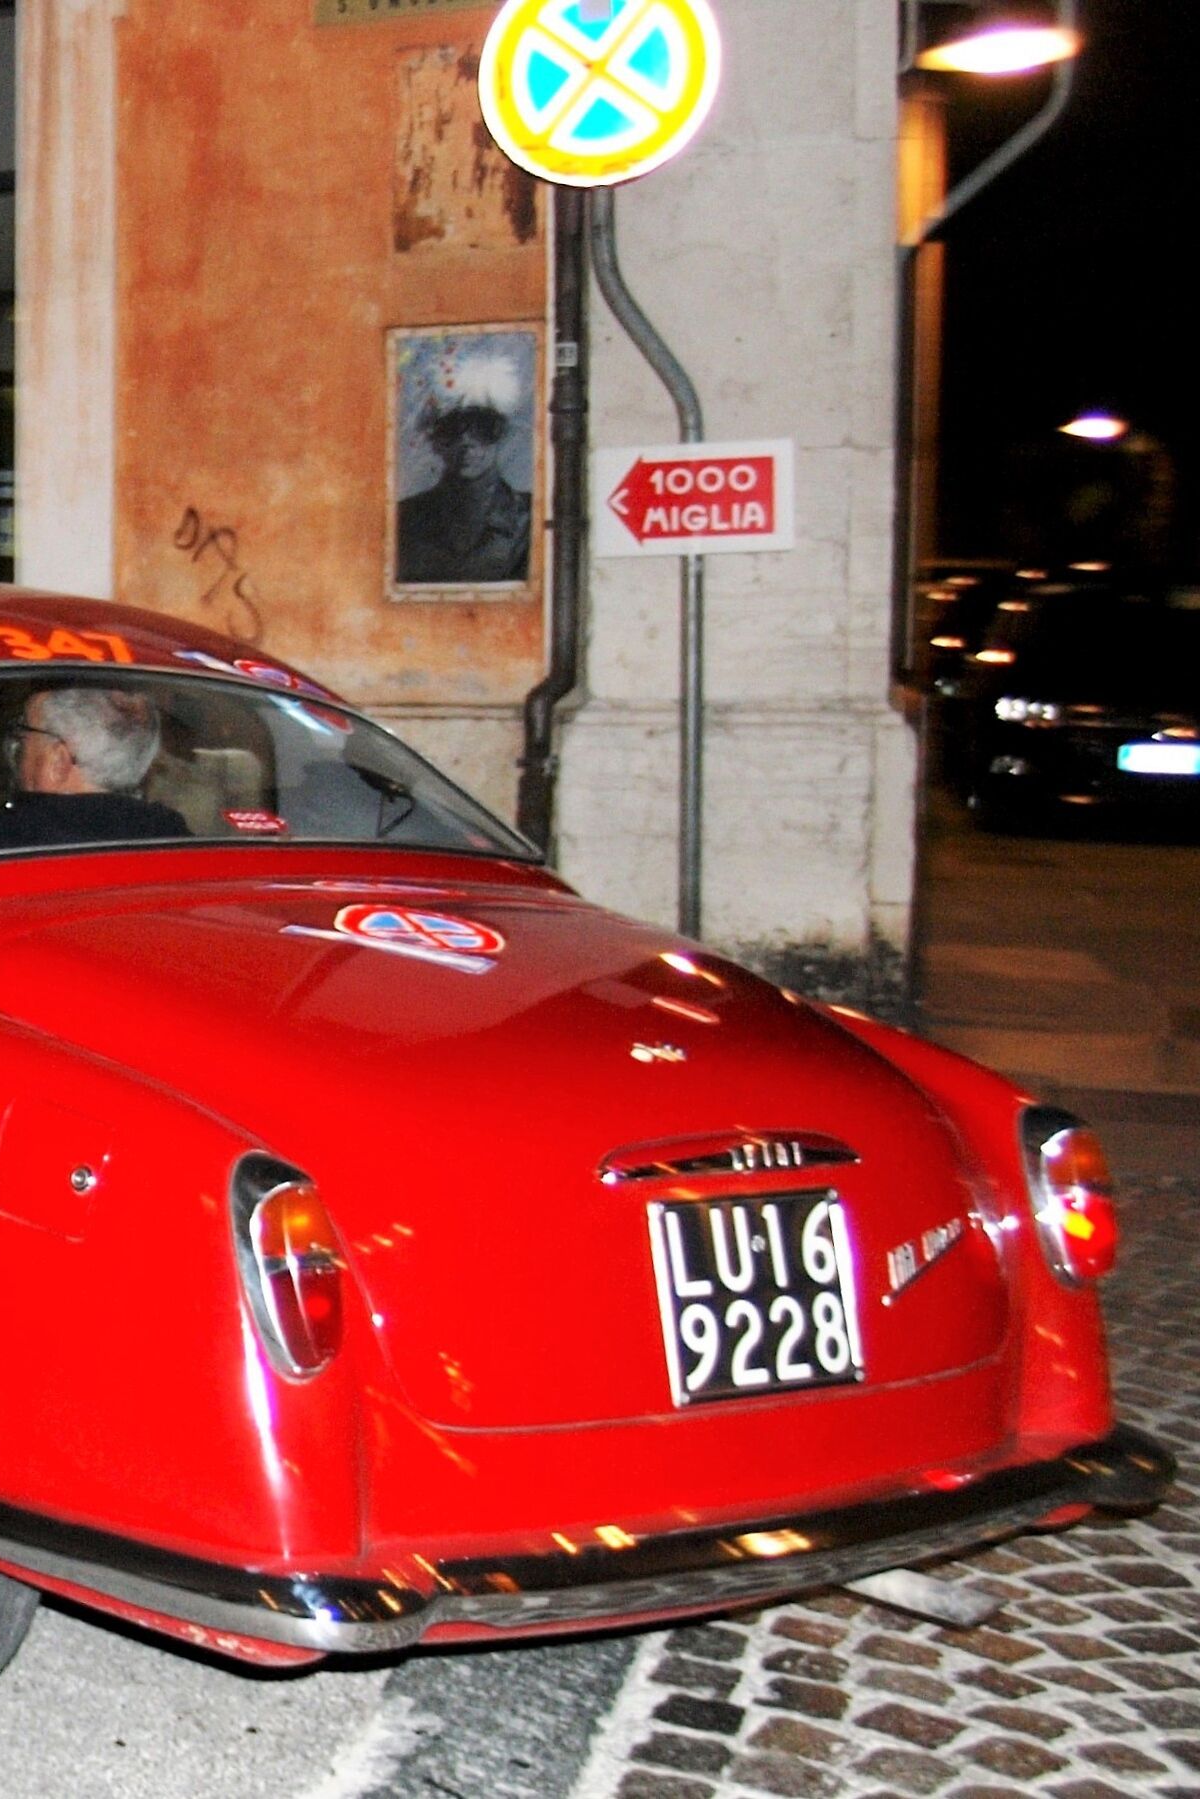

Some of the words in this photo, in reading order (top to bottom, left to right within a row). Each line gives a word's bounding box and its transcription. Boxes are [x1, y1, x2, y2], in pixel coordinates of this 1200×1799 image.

[650, 464, 758, 495] 1000
[641, 501, 767, 534] MIGLIA
[679, 1290, 850, 1392] 9228
